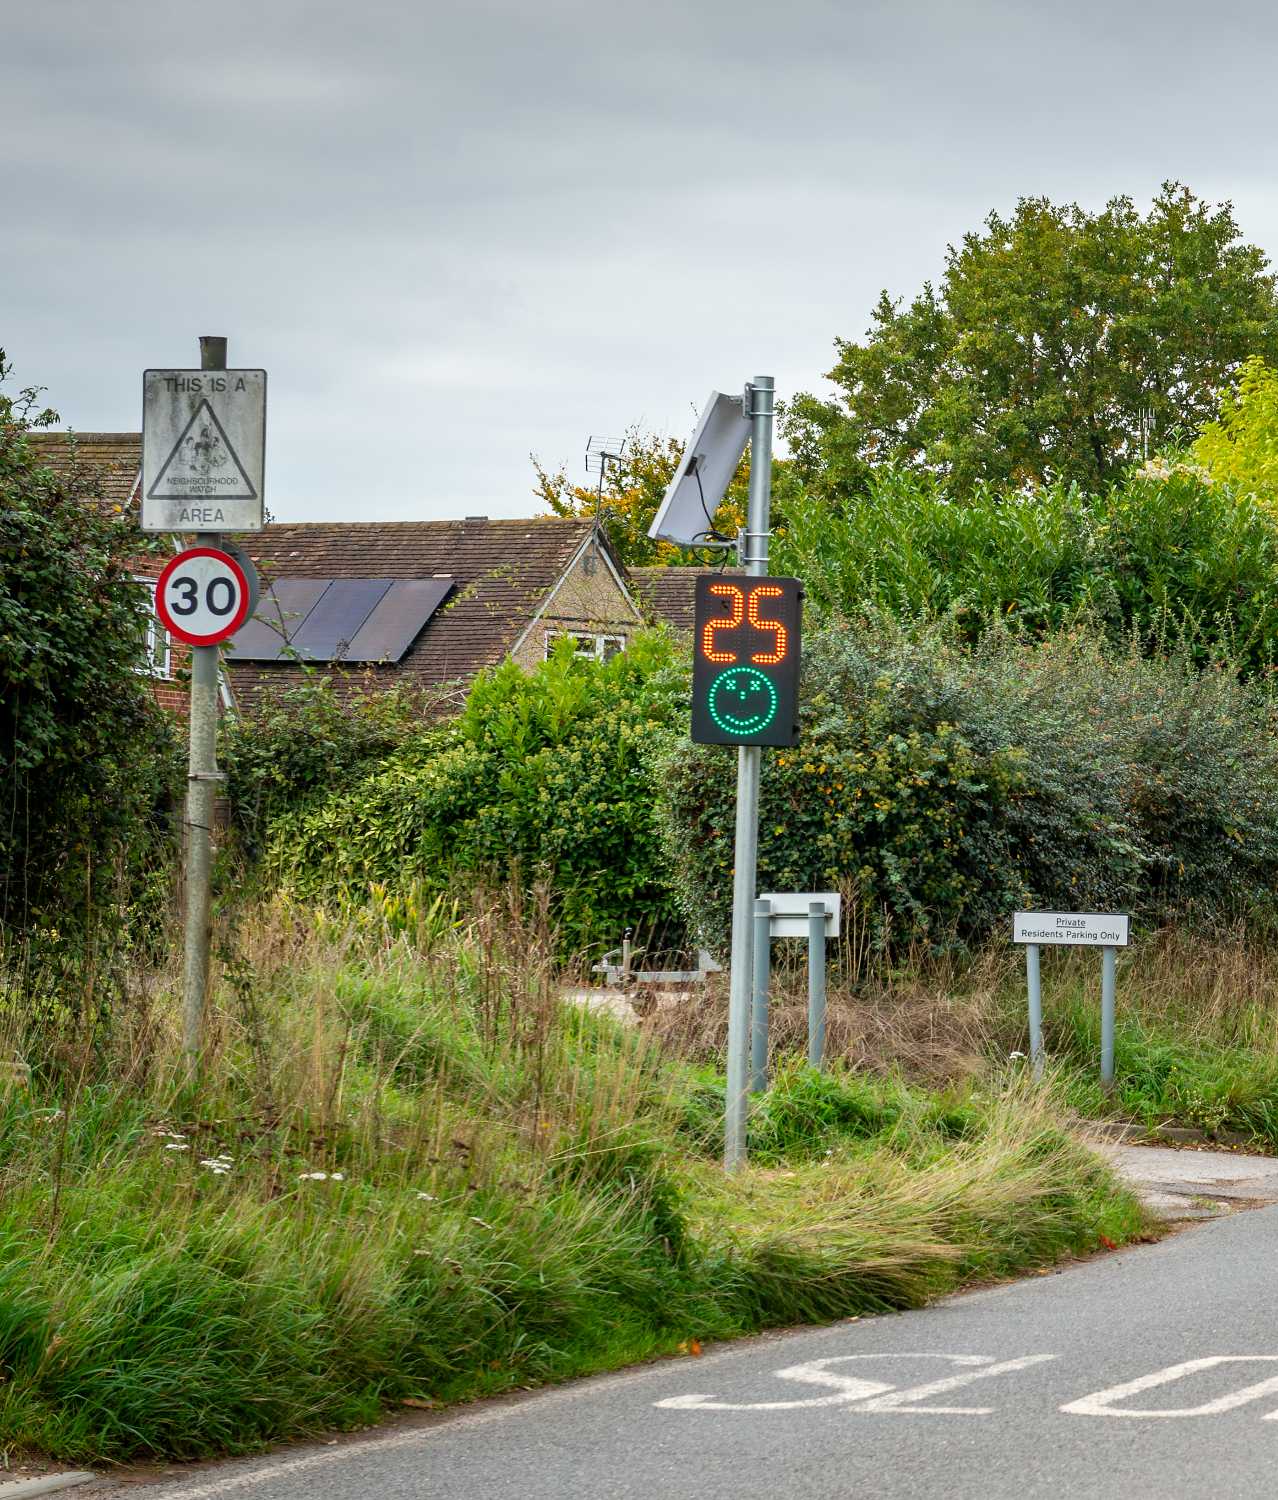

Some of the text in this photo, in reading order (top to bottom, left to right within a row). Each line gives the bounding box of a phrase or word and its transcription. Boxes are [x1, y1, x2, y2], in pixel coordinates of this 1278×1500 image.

[163, 377, 246, 392] THIS IS A
[167, 477, 238, 486] NEIGHBOURHOOD
[189, 485, 216, 494] WATCH
[180, 508, 225, 522] AREA
[171, 576, 236, 616] 30
[703, 584, 786, 664] 25
[1056, 917, 1086, 927] Private
[1021, 929, 1120, 941] Residents Parking Only
